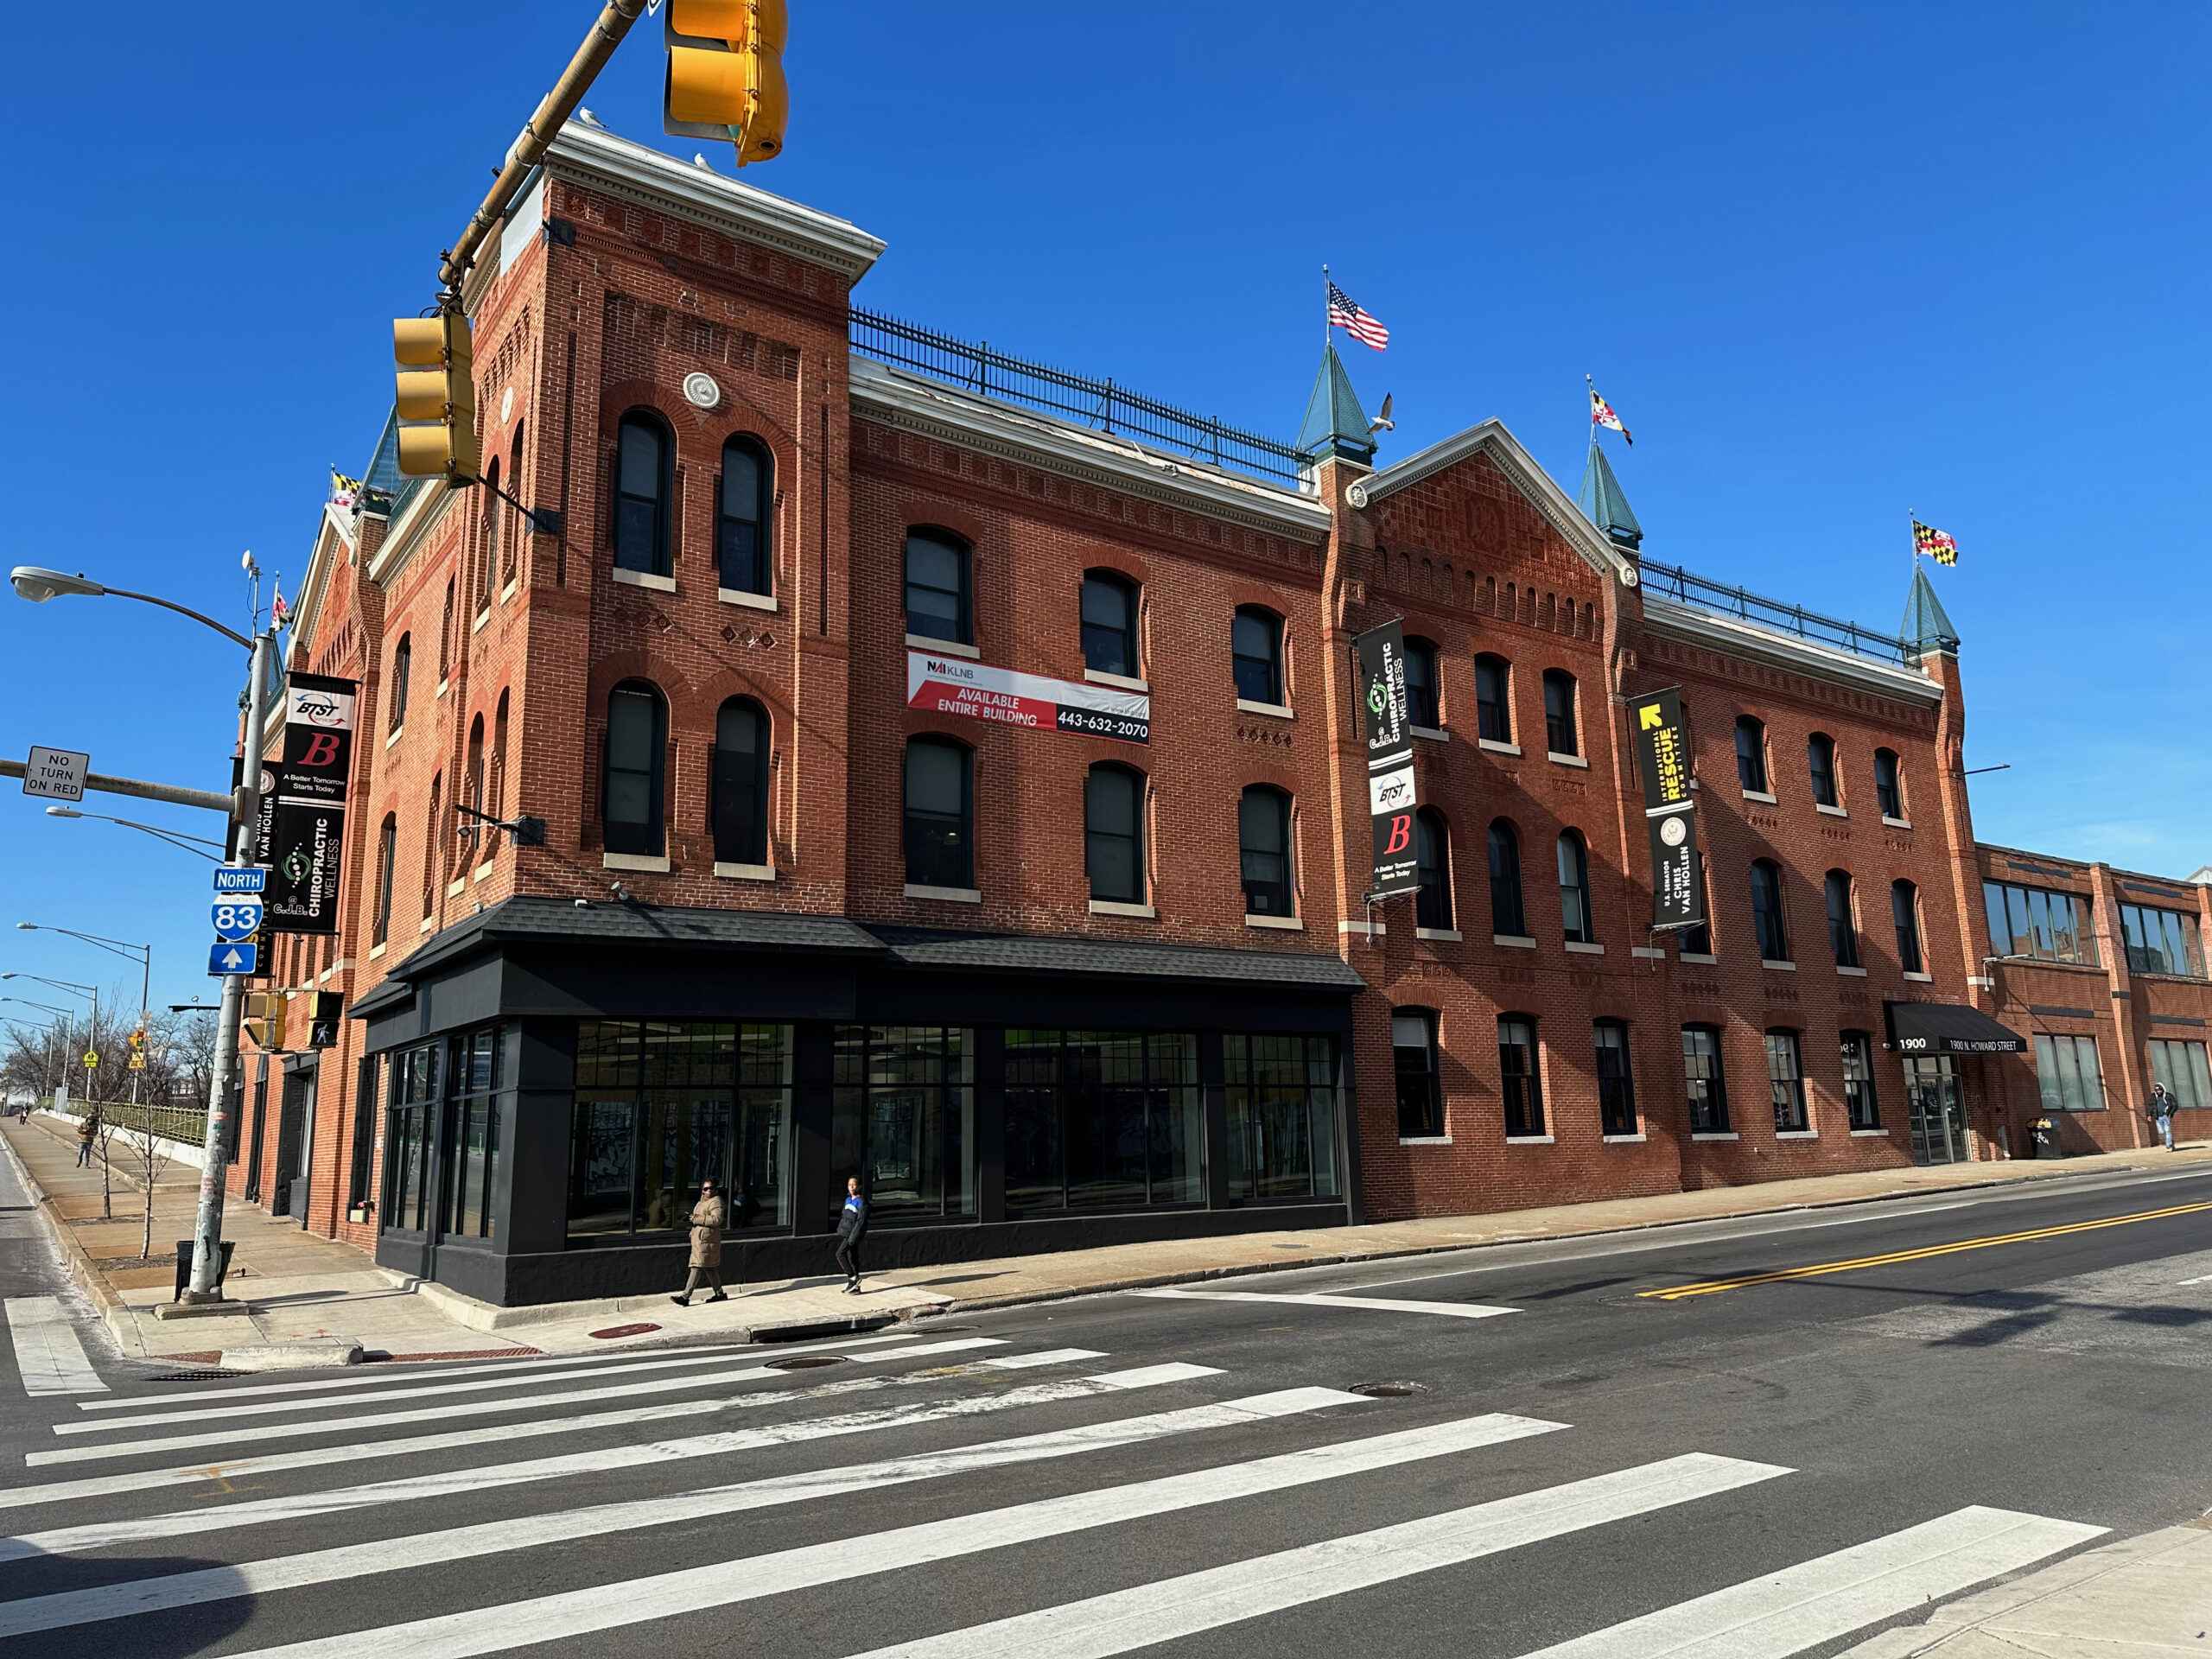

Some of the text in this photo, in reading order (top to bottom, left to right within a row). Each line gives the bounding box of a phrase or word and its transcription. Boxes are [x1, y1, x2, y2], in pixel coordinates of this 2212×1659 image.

[947, 666, 974, 679] KLNB
[957, 688, 1020, 709] AVAILABLE
[1382, 642, 1401, 743] CHIROPRACTIC
[1394, 658, 1407, 721] WELLNESS
[296, 702, 340, 716] BTST
[938, 698, 1037, 726] ENTIRE BUILDING
[1058, 711, 1148, 738] 443-632-2070
[49, 755, 69, 766] NO
[297, 733, 340, 766] B
[1653, 731, 1668, 802] INTERNATIONAL
[1659, 728, 1681, 801] RESCUE
[1671, 726, 1687, 798] COMMITTEE
[41, 767, 73, 780] TURN
[313, 776, 346, 785] Tomorrow
[29, 779, 79, 794] ON RED
[315, 785, 335, 794] Today
[1379, 783, 1406, 802] BTST
[260, 797, 273, 857] VAN HOLLEN
[1383, 815, 1411, 855] B
[308, 818, 327, 917] CHIROPRACTIC
[324, 838, 340, 899] WELLNESS
[1395, 870, 1411, 879] Today
[217, 872, 261, 888] NORTH
[1673, 867, 1682, 899] CHRIS
[1680, 846, 1691, 914] VAN HOLLEN
[273, 903, 308, 916] C.J.B.
[288, 895, 297, 905] @
[215, 906, 257, 930] 83
[1899, 1038, 1926, 1049] 1900
[1950, 1039, 2016, 1051] 1900 N. HOWARD STREET
